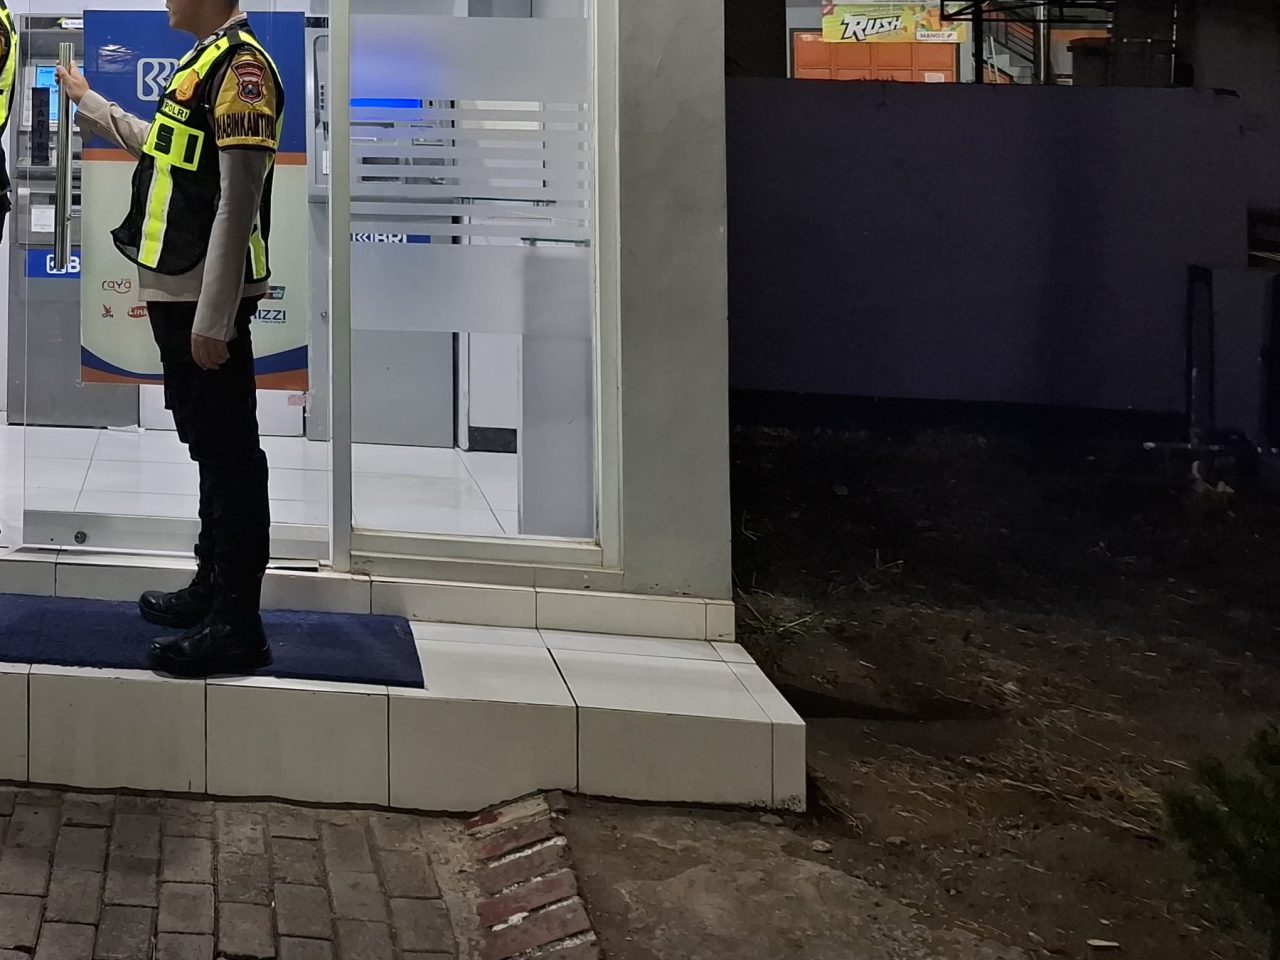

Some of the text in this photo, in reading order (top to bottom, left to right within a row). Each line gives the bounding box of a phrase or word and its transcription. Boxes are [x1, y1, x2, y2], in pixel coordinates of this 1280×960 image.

[840, 13, 903, 42] RUSH
[163, 101, 189, 120] POLRI
[153, 122, 200, 165] SI
[101, 280, 132, 289] raya
[254, 309, 286, 321] IZZI
